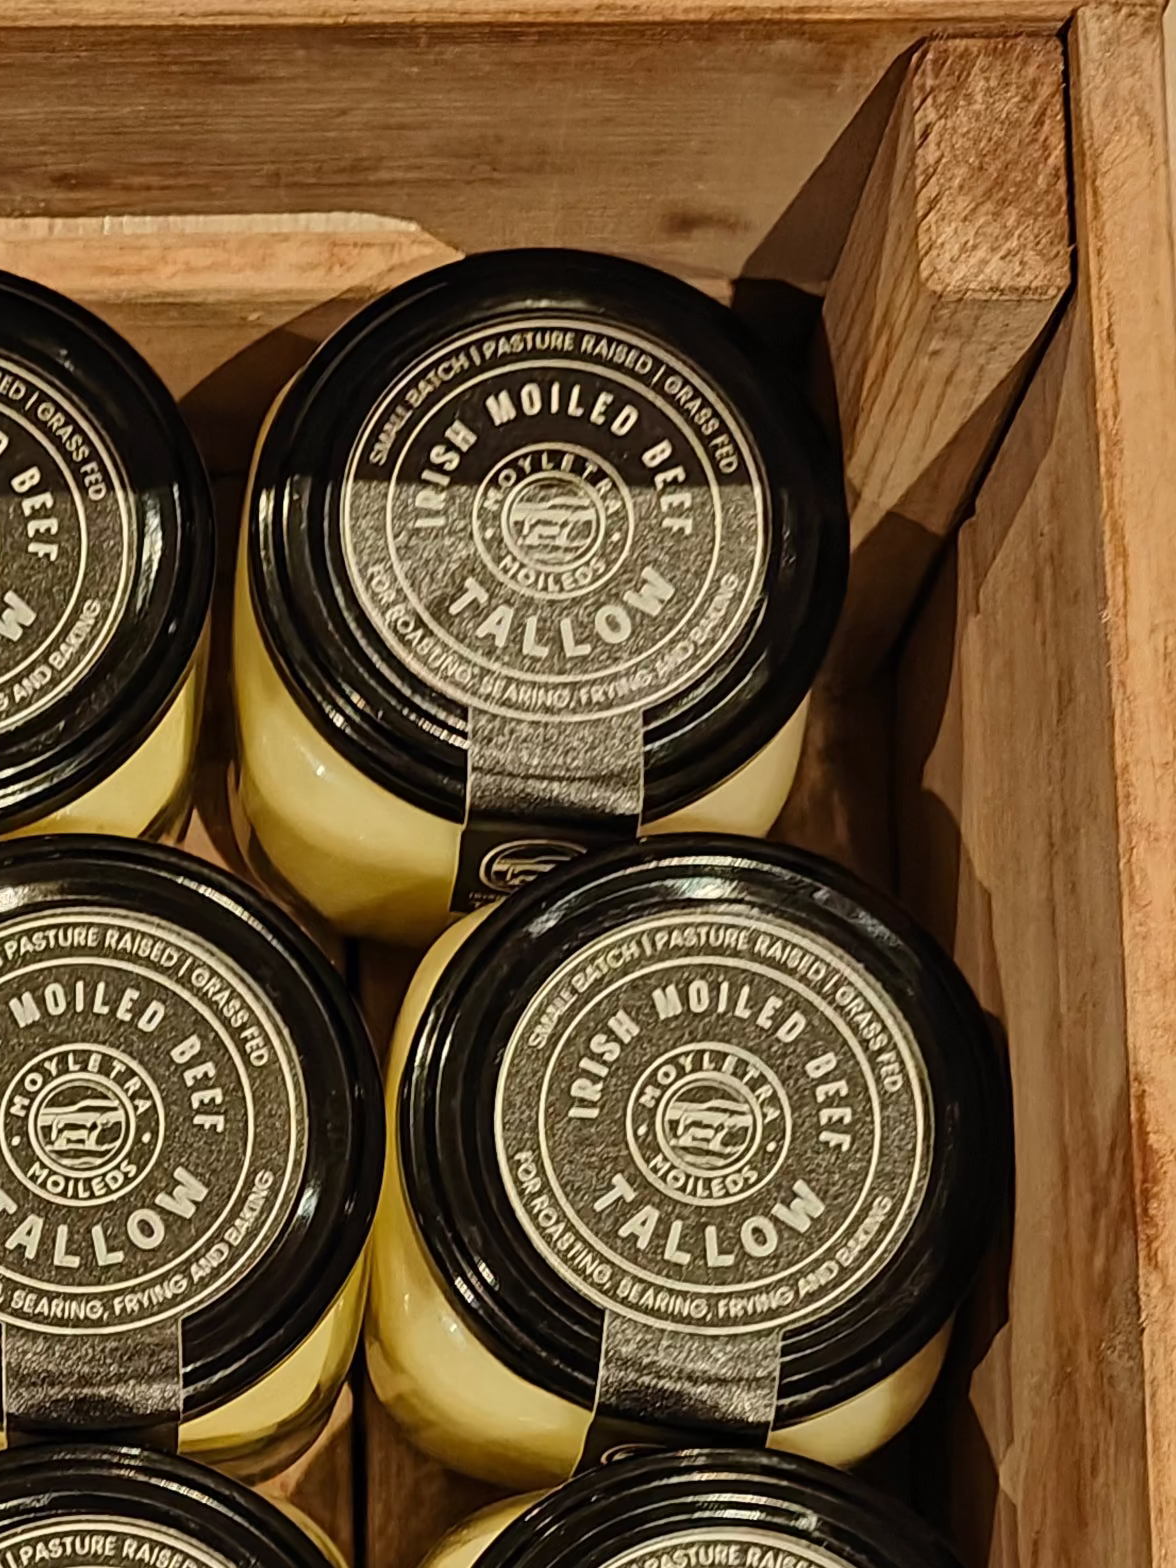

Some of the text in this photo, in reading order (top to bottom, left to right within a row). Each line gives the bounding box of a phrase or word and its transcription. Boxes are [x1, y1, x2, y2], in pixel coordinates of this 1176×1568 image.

[415, 382, 693, 535] IRISH MOILED BEEF
[11, 466, 58, 561] BEEF
[450, 565, 674, 657] TALLOW
[8, 980, 165, 1032] MOILED
[171, 1034, 225, 1133] BEEF
[10, 1052, 152, 1116] MOYLETRA
[569, 979, 852, 1152] IRISH MOILED BEEF
[27, 1158, 137, 1198] MOILEDS
[594, 1174, 825, 1266] TALLOW
[19, 1534, 116, 1565] PASTURE
